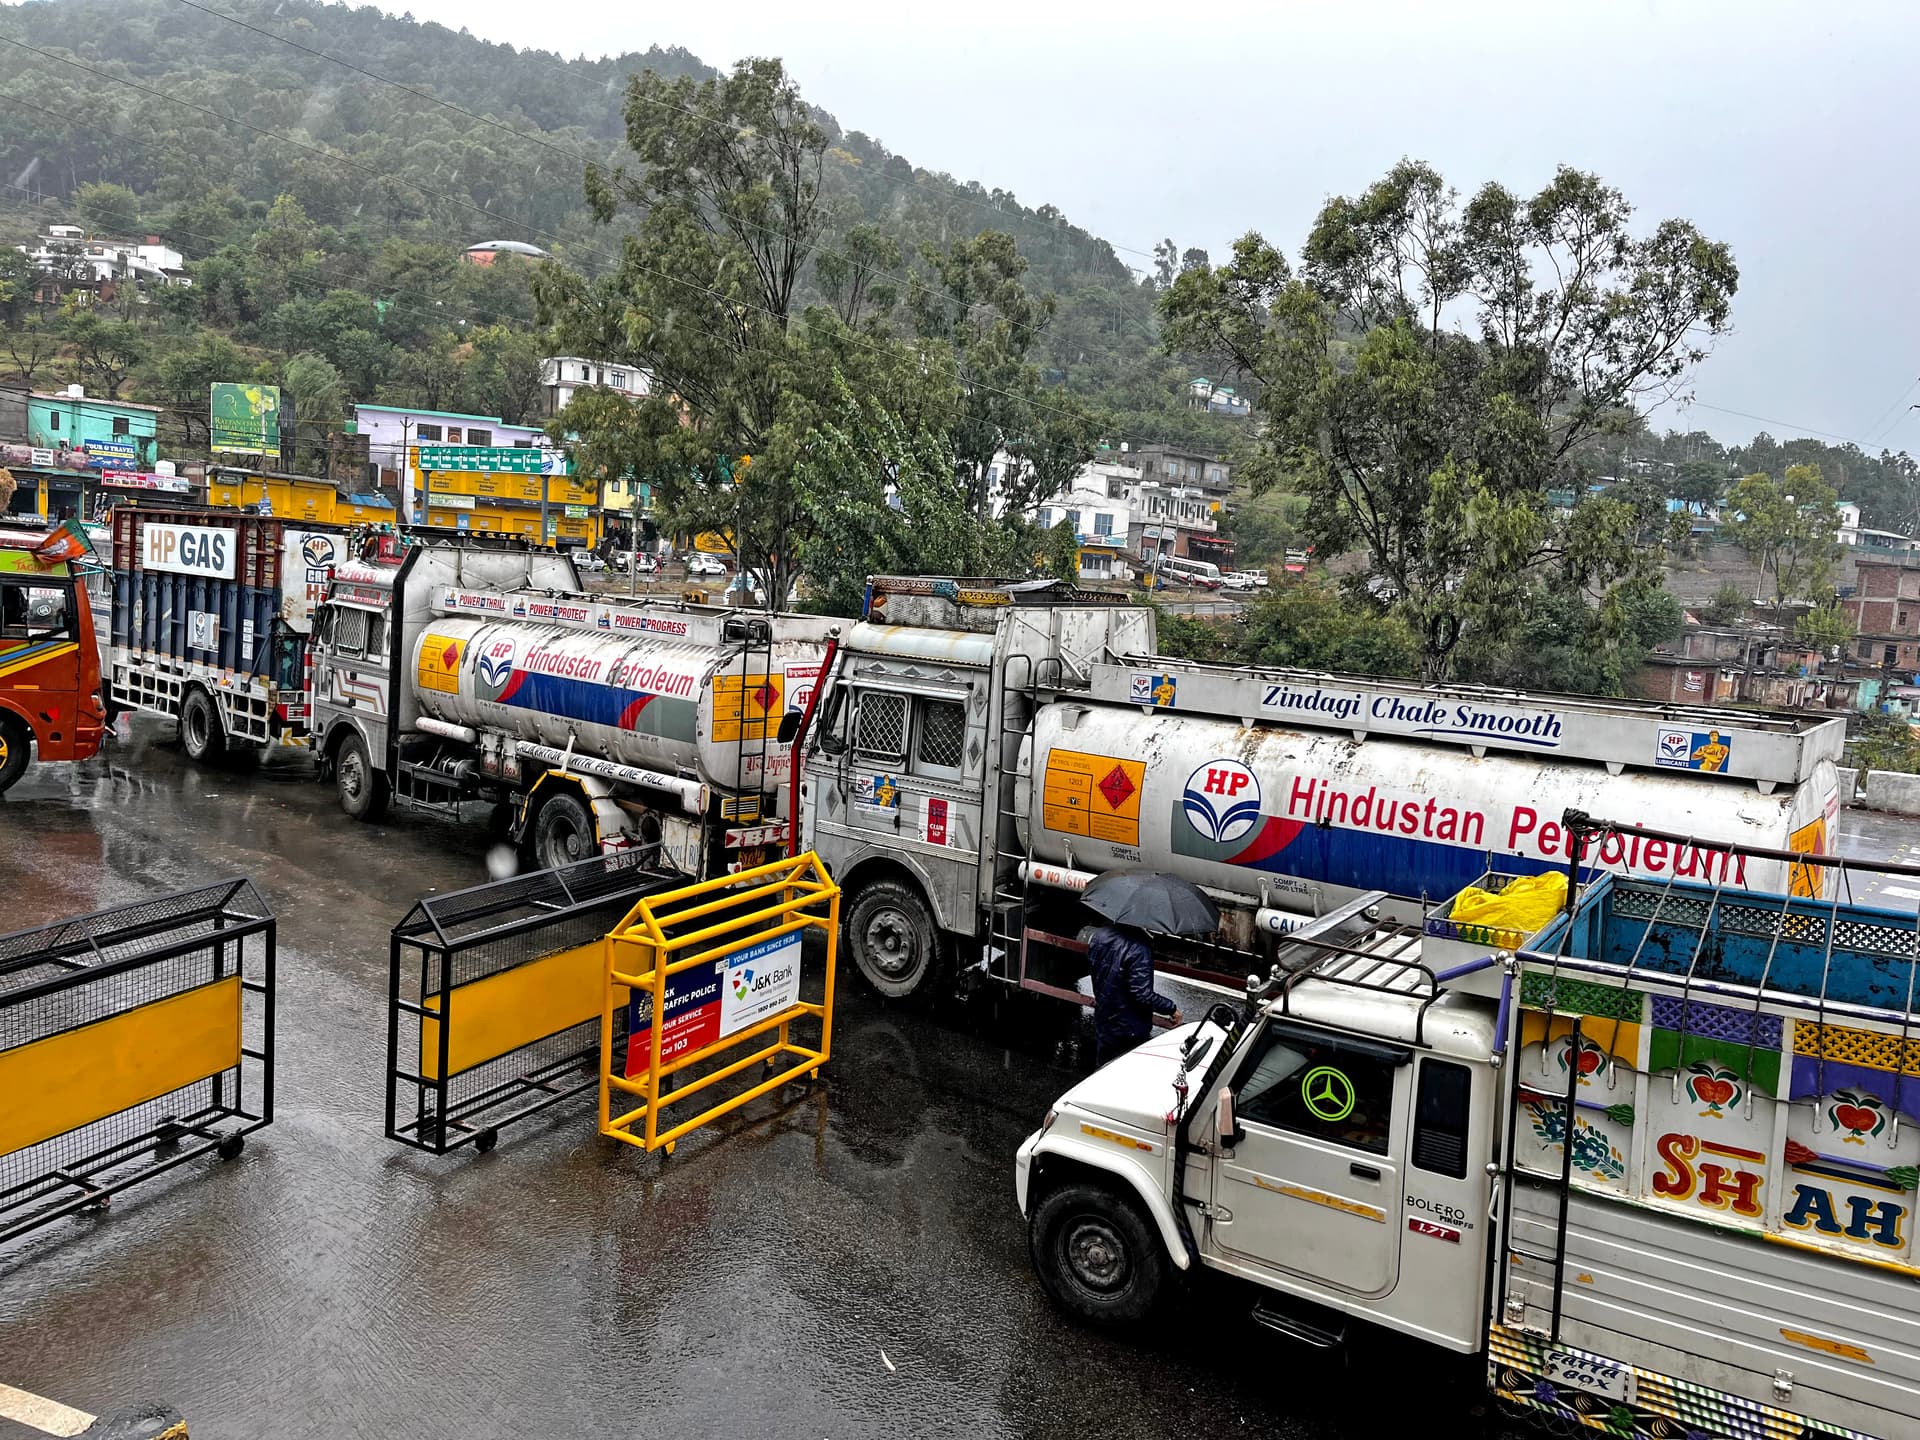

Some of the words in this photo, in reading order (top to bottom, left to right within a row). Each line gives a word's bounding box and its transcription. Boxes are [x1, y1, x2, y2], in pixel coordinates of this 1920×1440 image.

[150, 529, 176, 563] HP
[180, 531, 226, 571] GAS
[311, 540, 328, 551] HP
[459, 594, 480, 607] POWER
[486, 597, 506, 610] THRILL
[529, 603, 553, 616] POWER
[557, 606, 588, 621] PROTECT
[615, 615, 641, 628] POWER
[646, 618, 687, 634] PROGRESS
[490, 643, 512, 658] HP
[523, 643, 602, 680] Hindustan
[606, 657, 695, 697] Petroleum
[1262, 685, 1362, 719] Zindagi
[1371, 696, 1447, 725] Chale
[1452, 704, 1563, 738] Smooth
[1668, 736, 1684, 745] HP
[571, 756, 592, 769] WITH
[594, 761, 617, 775] PIPE
[619, 766, 640, 780] LINE
[1203, 768, 1250, 797] HP
[1288, 775, 1485, 845] Hindustan
[1046, 870, 1060, 884] NO
[1273, 877, 1297, 886] COMPT
[733, 952, 749, 964] YOUR
[749, 946, 766, 958] BANK
[766, 940, 783, 952] SINCE
[751, 973, 772, 993] J&K
[773, 964, 793, 984] Bank
[663, 994, 690, 1011] RAFFIC
[690, 983, 717, 1000] POLICE
[677, 1008, 703, 1025] SERVICE
[674, 1038, 688, 1052] 103
[1652, 1132, 1764, 1218] SH
[1783, 1183, 1909, 1251] AH
[1405, 1195, 1465, 1220] BOLERO
